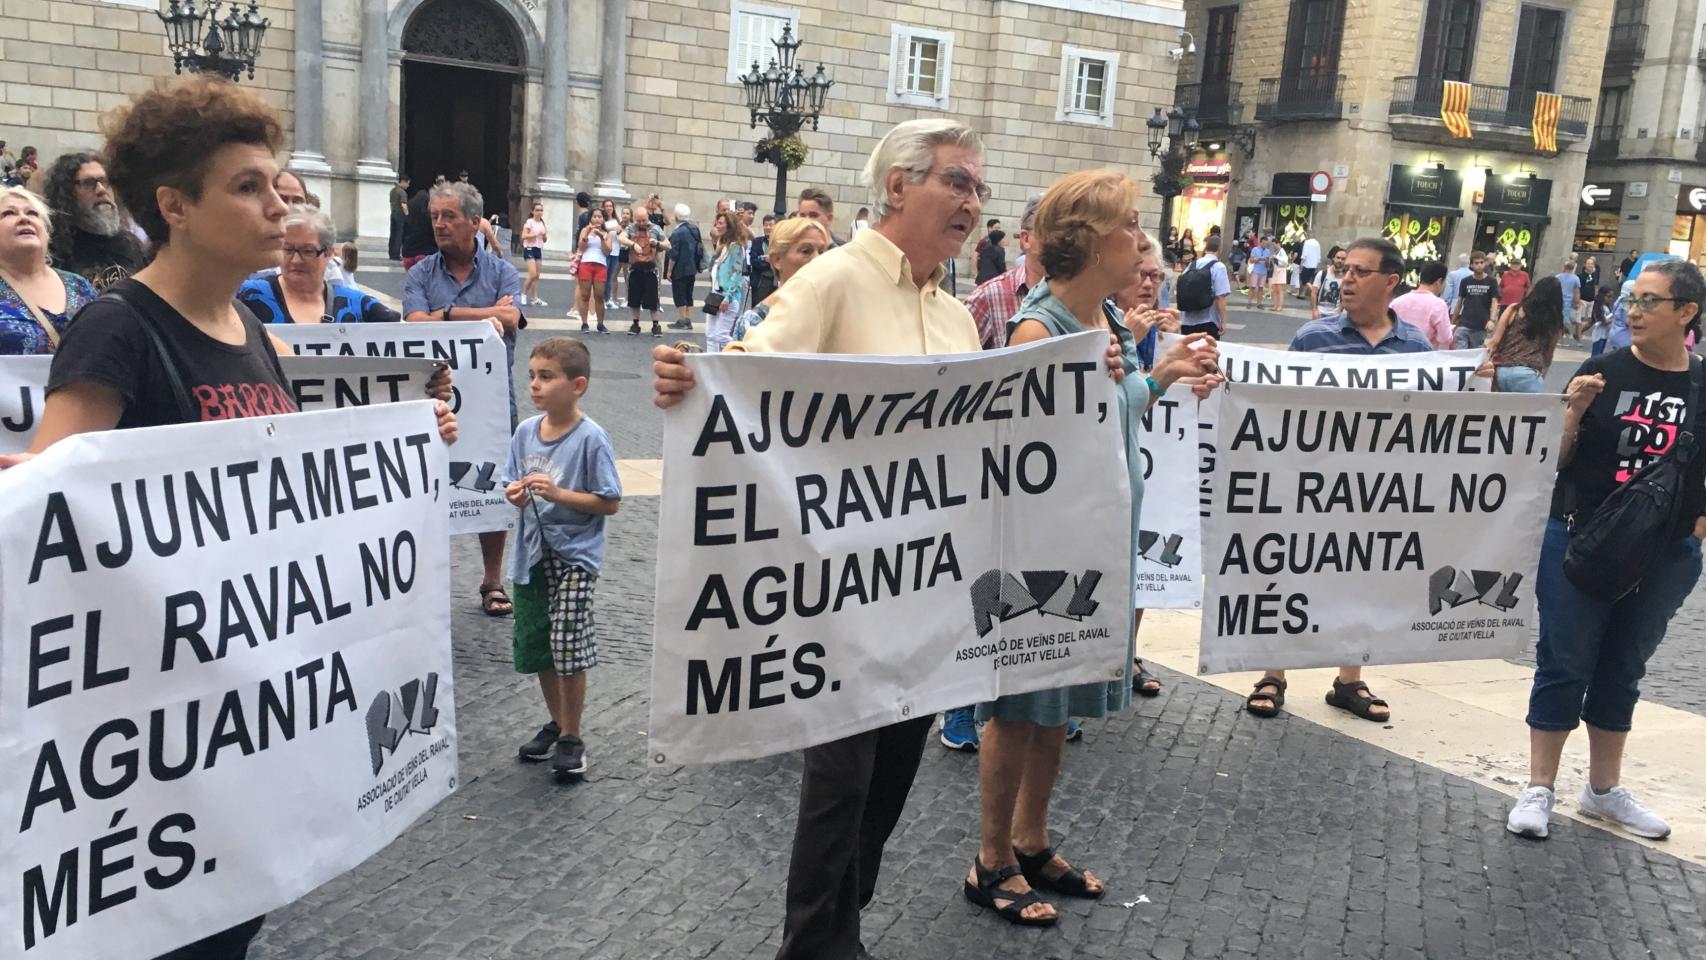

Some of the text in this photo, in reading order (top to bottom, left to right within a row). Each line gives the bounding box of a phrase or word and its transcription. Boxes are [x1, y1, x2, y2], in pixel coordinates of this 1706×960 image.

[1416, 180, 1438, 190] TOUCH
[1506, 189, 1527, 198] TOUCH
[1225, 357, 1476, 392] UNTAMENT,
[692, 362, 1107, 457] AJUNTAMENT,
[1230, 408, 1549, 464] AJUNTAMENT,
[28, 433, 440, 584] AJUNTAMENT,
[470, 500, 484, 508] DEL
[485, 498, 506, 506] RAVAL
[693, 440, 1057, 547] EL RAVAL NO
[1226, 471, 1507, 514] EL RAVAL NO
[459, 509, 481, 518] VELLA
[1219, 530, 1425, 576] AGUANTA
[684, 532, 962, 631] AGUANTA
[1145, 583, 1165, 591] VELLA
[1156, 573, 1169, 581] DEL
[1170, 573, 1192, 582] RAVAL
[27, 529, 417, 709] EL RAVAL NO
[1217, 582, 1320, 637] MÉS.
[1411, 620, 1455, 631] ASSOCIACIÓ
[1456, 621, 1466, 630] DE
[1487, 619, 1500, 627] DEL
[1502, 618, 1524, 627] RAVAL
[1010, 638, 1024, 651] DE
[1026, 632, 1055, 648] VEÏNS
[1057, 631, 1077, 644] DEL
[1078, 627, 1110, 641] RAVAL
[1438, 630, 1495, 642] DE CIUTAT VELLA
[685, 634, 841, 716] MÉS.
[1001, 651, 1036, 667] CIUTAT
[1039, 646, 1070, 661] VELLA
[19, 650, 358, 834] AGUANTA
[384, 795, 394, 813] DE
[22, 807, 217, 951] MÉS.
